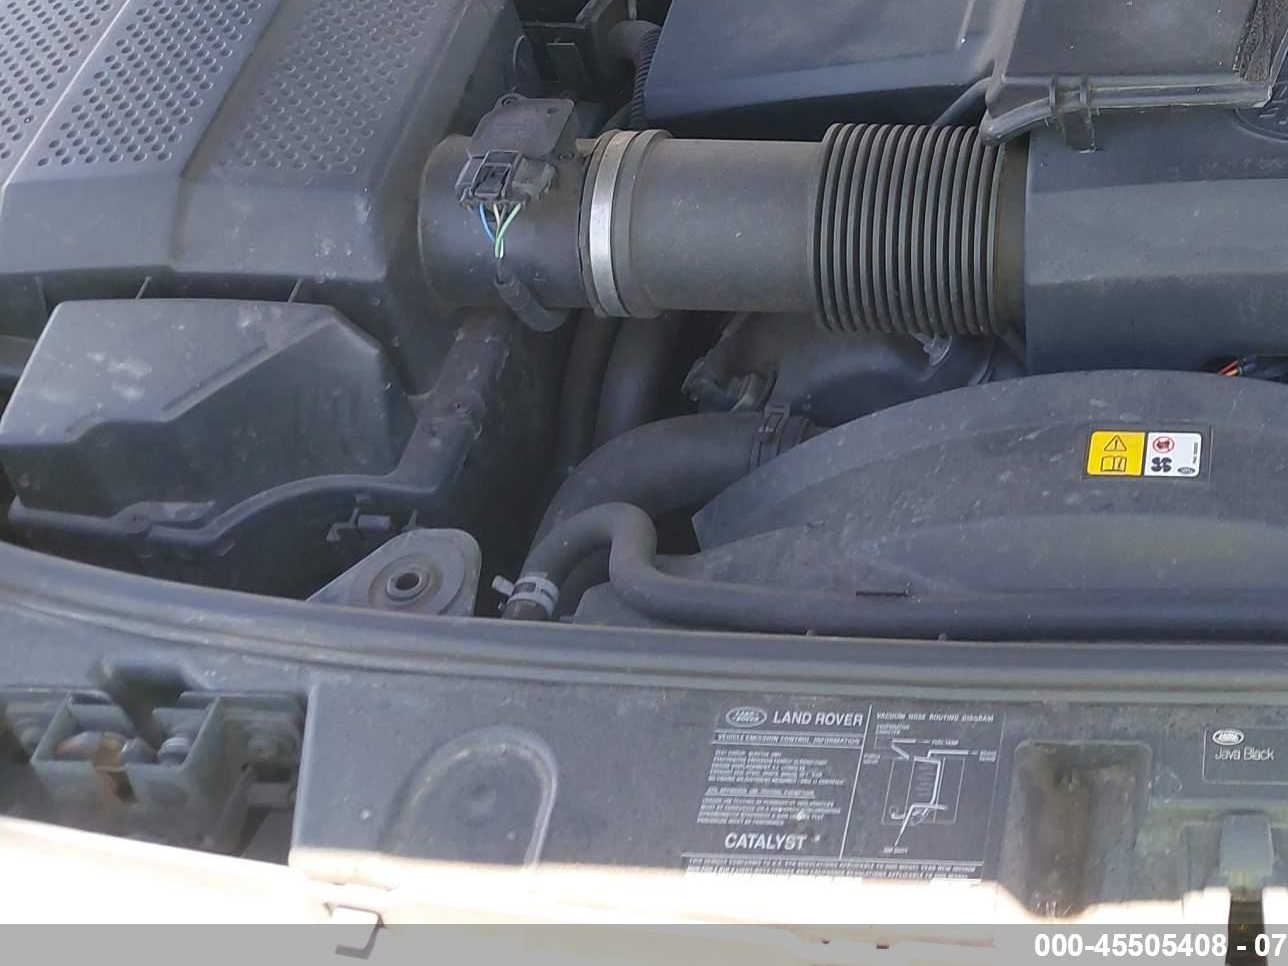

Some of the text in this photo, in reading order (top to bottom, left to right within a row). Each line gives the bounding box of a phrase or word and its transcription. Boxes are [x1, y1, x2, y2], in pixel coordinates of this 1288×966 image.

[773, 710, 864, 727] LAND ROVER
[1215, 746, 1275, 761] Java Black
[725, 832, 808, 850] CATALYST
